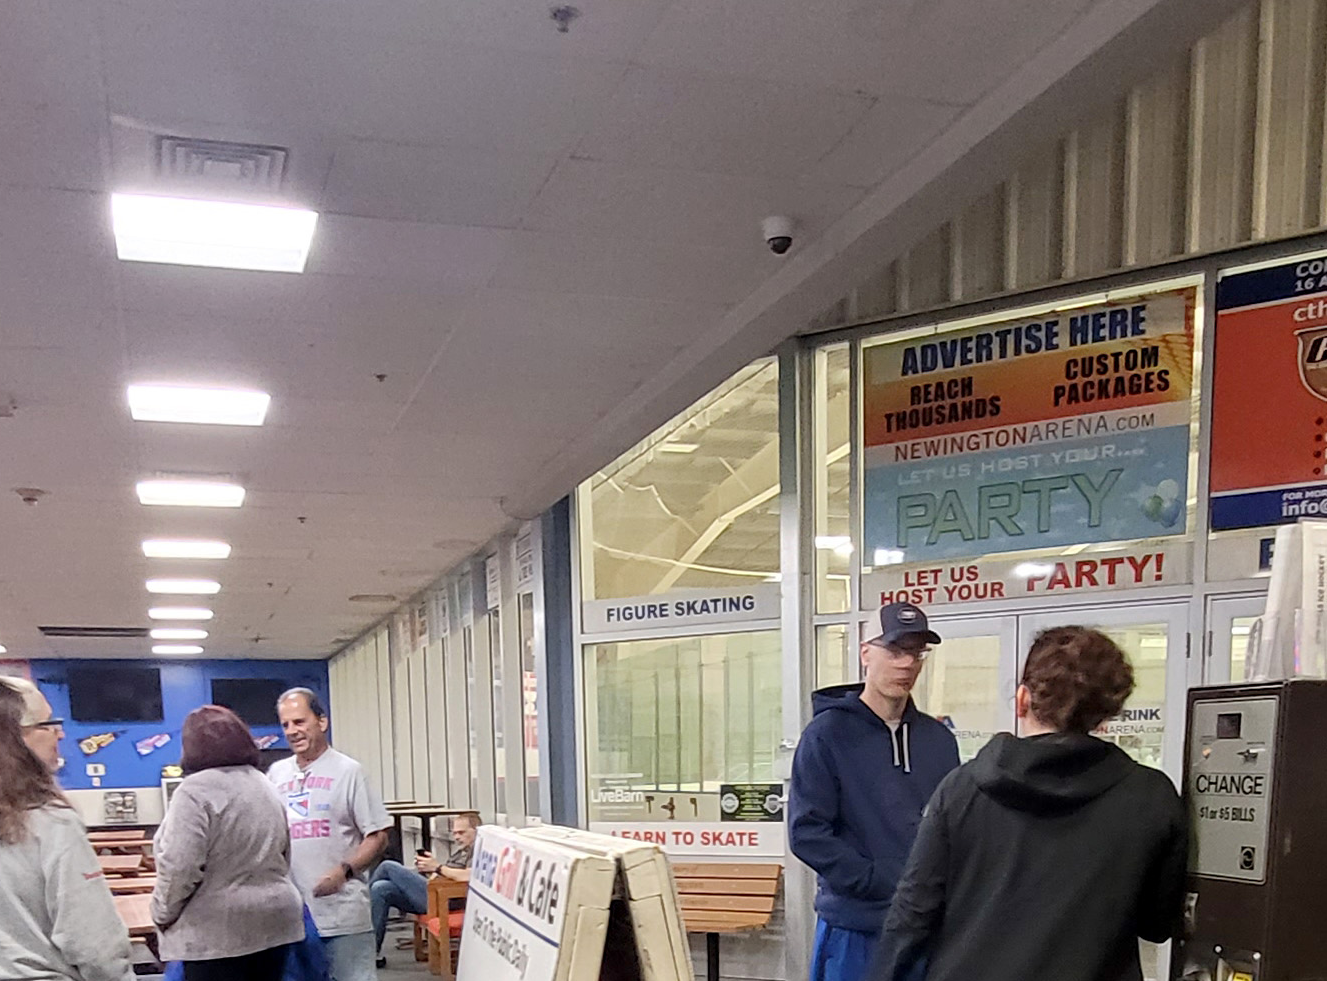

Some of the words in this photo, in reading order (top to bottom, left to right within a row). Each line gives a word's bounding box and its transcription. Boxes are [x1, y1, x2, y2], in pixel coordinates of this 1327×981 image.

[901, 320, 1060, 376] ADVERTISE
[1069, 304, 1147, 347] HERE
[1065, 346, 1159, 380] CUSTOM
[910, 376, 973, 406] REACH
[1054, 369, 1170, 407] PACKAGES
[884, 395, 1001, 433] THOUSANDS
[895, 413, 1155, 462] NEWINGTONARENA.COM
[898, 469, 935, 486] LET
[942, 463, 971, 480] US
[981, 454, 1042, 475] HOST
[896, 468, 1124, 548] PARTY
[904, 568, 943, 587] LET
[950, 565, 978, 583] US
[606, 603, 669, 623] FIGURE
[674, 595, 755, 616] SKATING
[880, 587, 937, 606] HOST
[943, 582, 1004, 602] YOUR
[1123, 709, 1161, 721] RINK
[591, 788, 644, 803] LiveBarn
[1196, 774, 1264, 795] CHANGE
[1231, 807, 1255, 822] BILLS
[671, 832, 694, 845] TO
[700, 832, 759, 846] SKATE
[517, 855, 530, 907] &
[528, 860, 560, 925] Cafe
